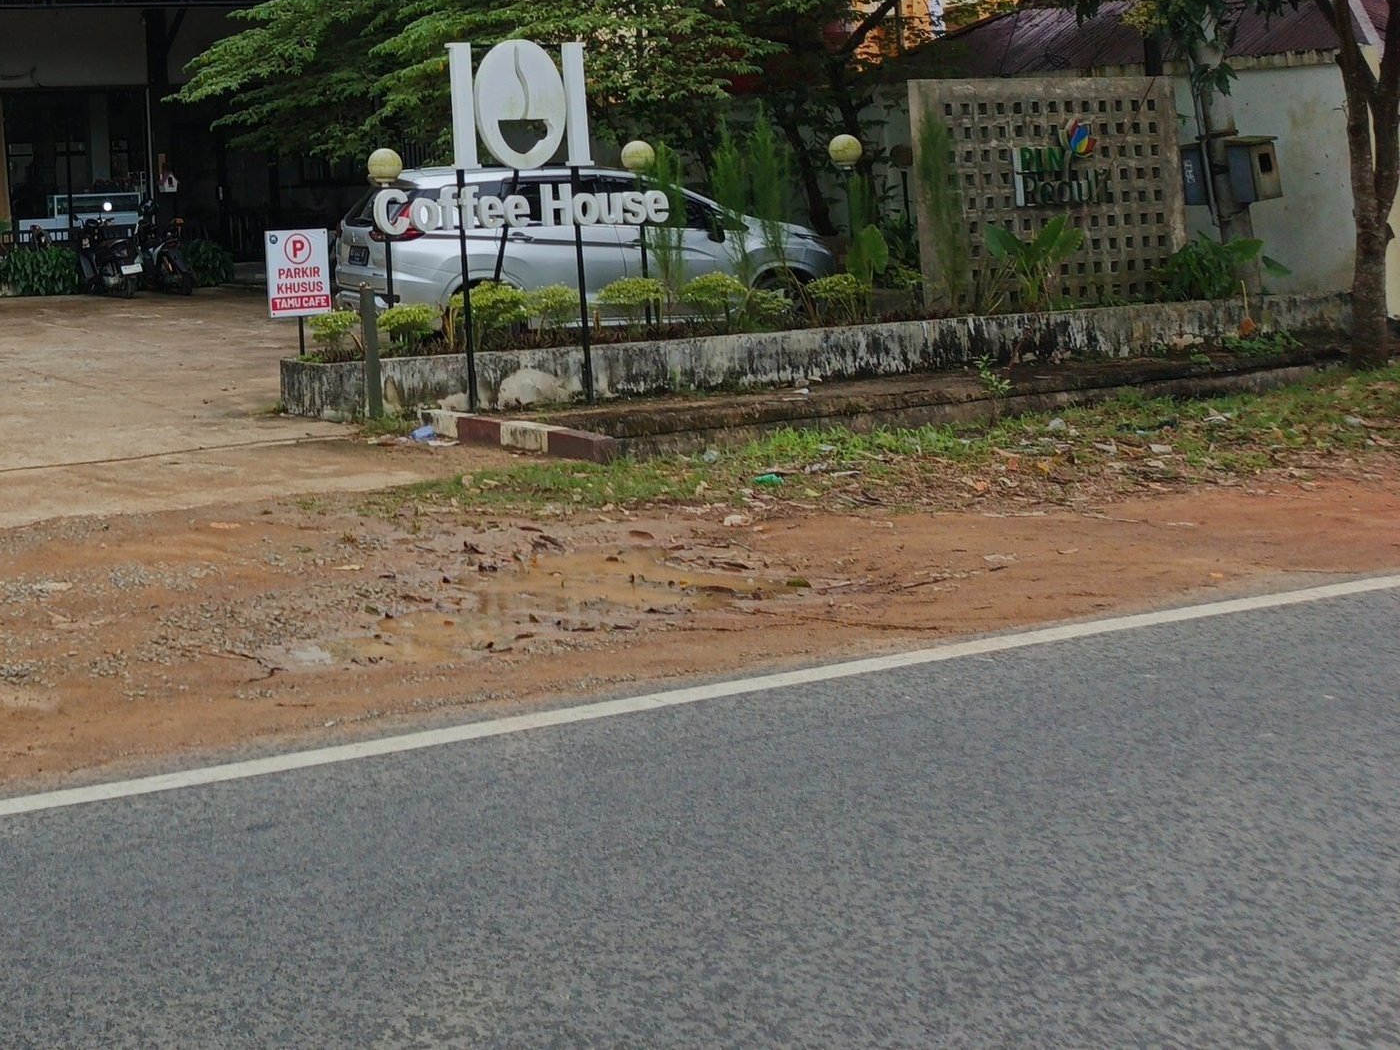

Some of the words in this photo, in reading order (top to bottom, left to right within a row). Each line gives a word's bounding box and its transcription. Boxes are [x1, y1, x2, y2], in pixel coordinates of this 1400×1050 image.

[445, 38, 595, 170] 101
[372, 184, 532, 236] Coffee
[539, 182, 670, 226] House
[292, 239, 304, 258] P
[278, 266, 320, 279] PARKIR
[276, 281, 323, 294] KHUSUS
[274, 297, 301, 309] TAMU
[302, 296, 327, 307] CAFE
